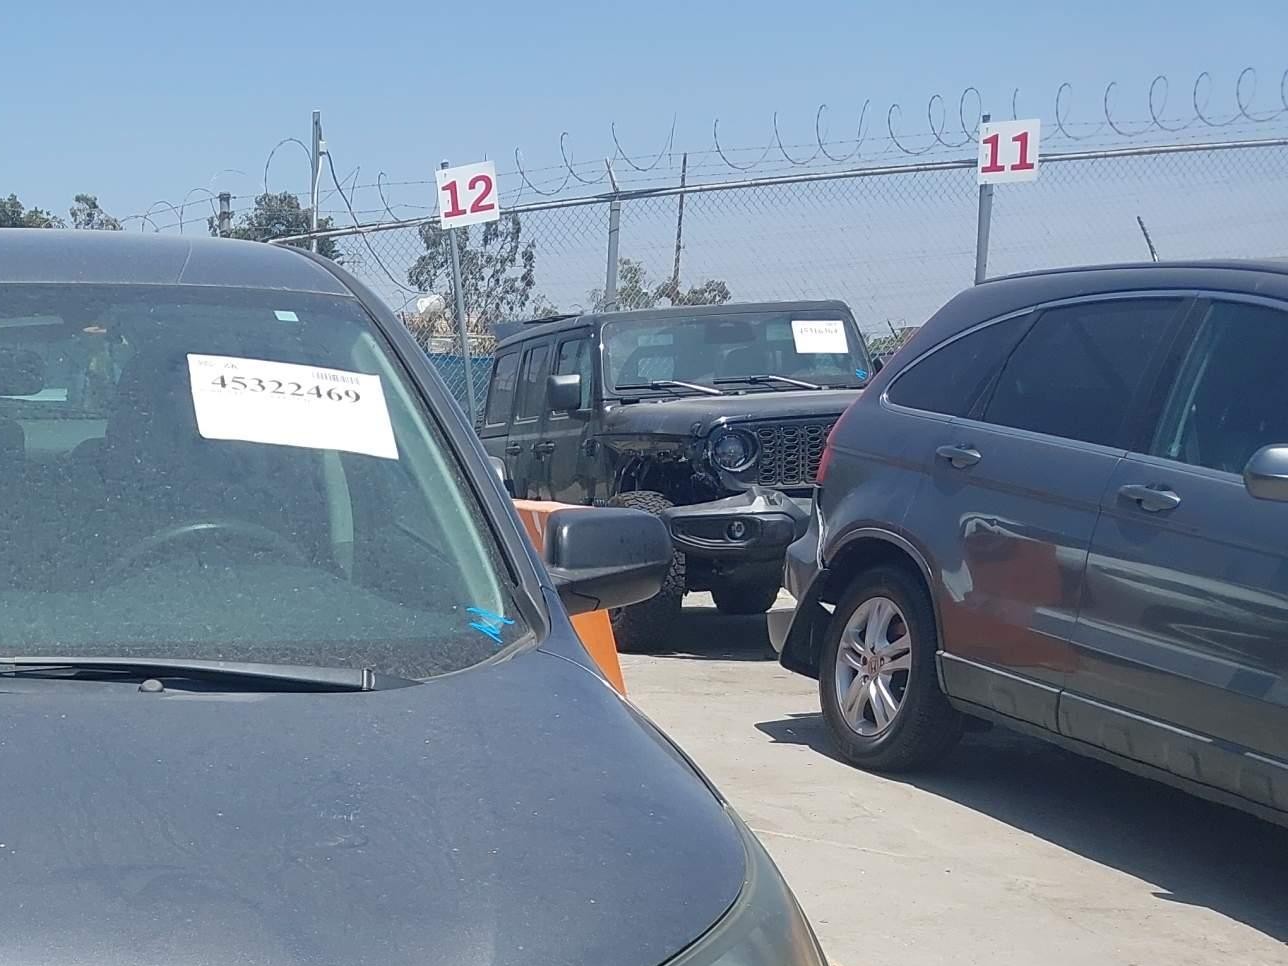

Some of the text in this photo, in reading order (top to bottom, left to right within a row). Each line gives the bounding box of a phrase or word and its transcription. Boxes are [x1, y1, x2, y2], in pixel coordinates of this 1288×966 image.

[981, 132, 1035, 173] 11
[441, 175, 495, 218] 12
[210, 373, 362, 404] 45322469
